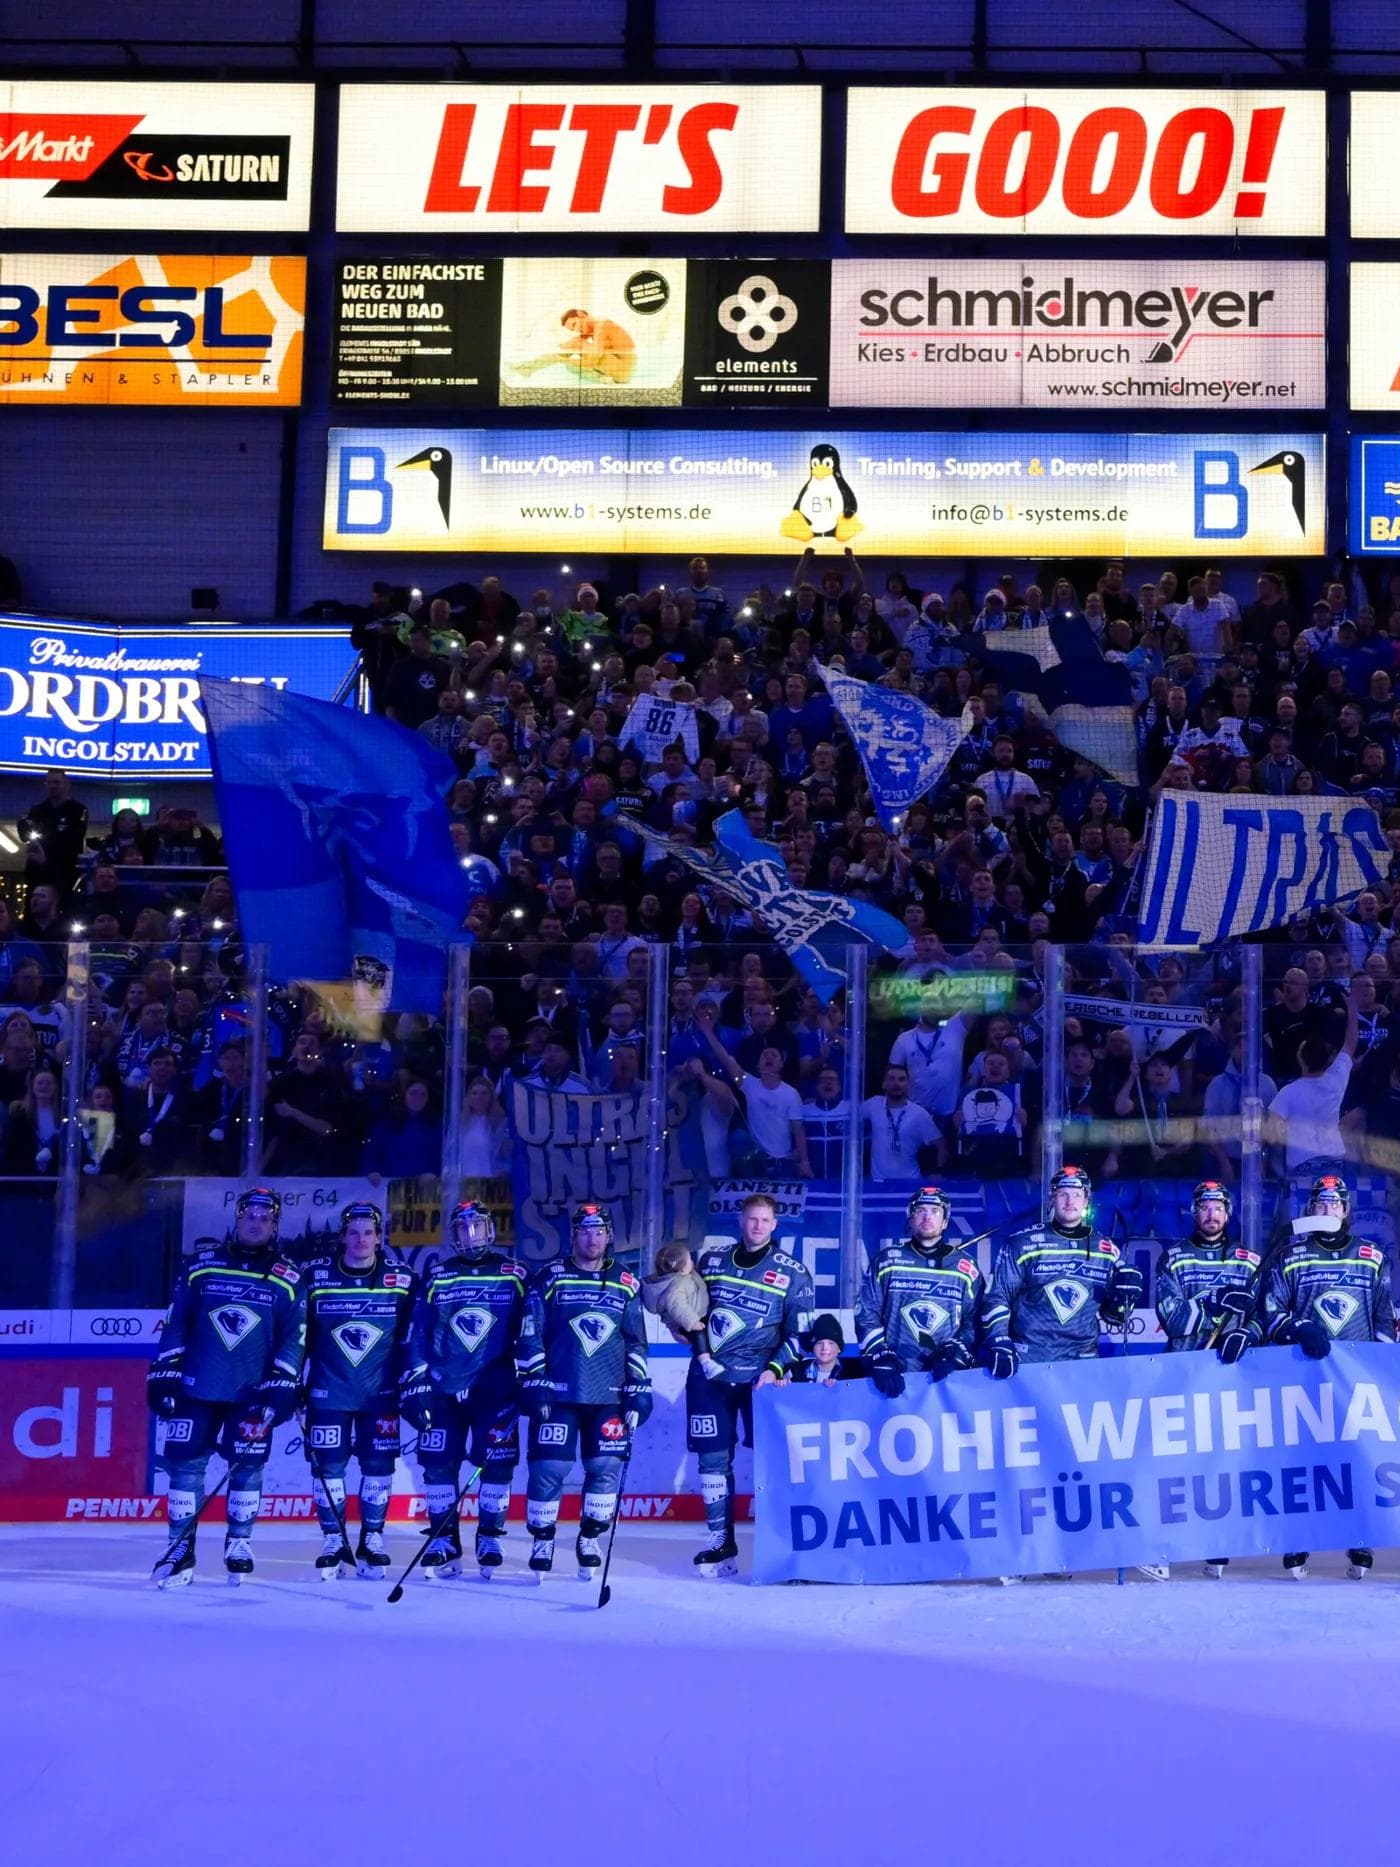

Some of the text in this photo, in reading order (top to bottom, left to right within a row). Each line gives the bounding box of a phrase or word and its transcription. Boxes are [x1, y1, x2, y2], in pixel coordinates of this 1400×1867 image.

[176, 154, 280, 183] SATURN
[423, 102, 739, 215] LET'S
[891, 105, 1286, 220] GOOO!
[343, 265, 485, 281] DER EINFACHSTE
[342, 284, 424, 299] WEG ZUM
[0, 285, 272, 347] BESL
[341, 303, 443, 319] NEUEN BAD
[859, 276, 1274, 345] schmidmeyer
[857, 343, 1130, 364] Kies Erdbau Abbruch
[715, 359, 798, 373] elements
[118, 374, 128, 385] &
[153, 373, 272, 386] STAPLER
[701, 384, 718, 392] BAD
[728, 384, 765, 392] HEIZUNG
[775, 384, 811, 392] ENERGIE
[1047, 377, 1297, 403] www.schmidmeyer.net
[481, 456, 778, 480] Linux/Open Source Consulting.
[857, 457, 1178, 480] Training, Support & Development
[520, 503, 712, 522] www.b1-systems.de
[932, 504, 1129, 524] info@b1-systems.de
[30, 636, 203, 672] Privatbrauerei
[0, 667, 289, 734] ORDBR
[646, 708, 676, 735] 86
[23, 736, 199, 761] INGOLSTADT
[1065, 1003, 1203, 1023] ERISCHE REBELLEN
[312, 1189, 338, 1206] 64
[13, 1387, 113, 1458] di
[693, 1419, 713, 1434] DB
[313, 1429, 337, 1445] DB
[420, 1432, 443, 1448] DB
[542, 1428, 564, 1443] DB
[786, 1405, 1040, 1484] FROHE
[66, 1498, 160, 1518] PENNY
[258, 1498, 318, 1518] ENN
[789, 1491, 997, 1552] DANKE
[1020, 1471, 1140, 1536] FÜR
[1159, 1462, 1353, 1525] EUREN
